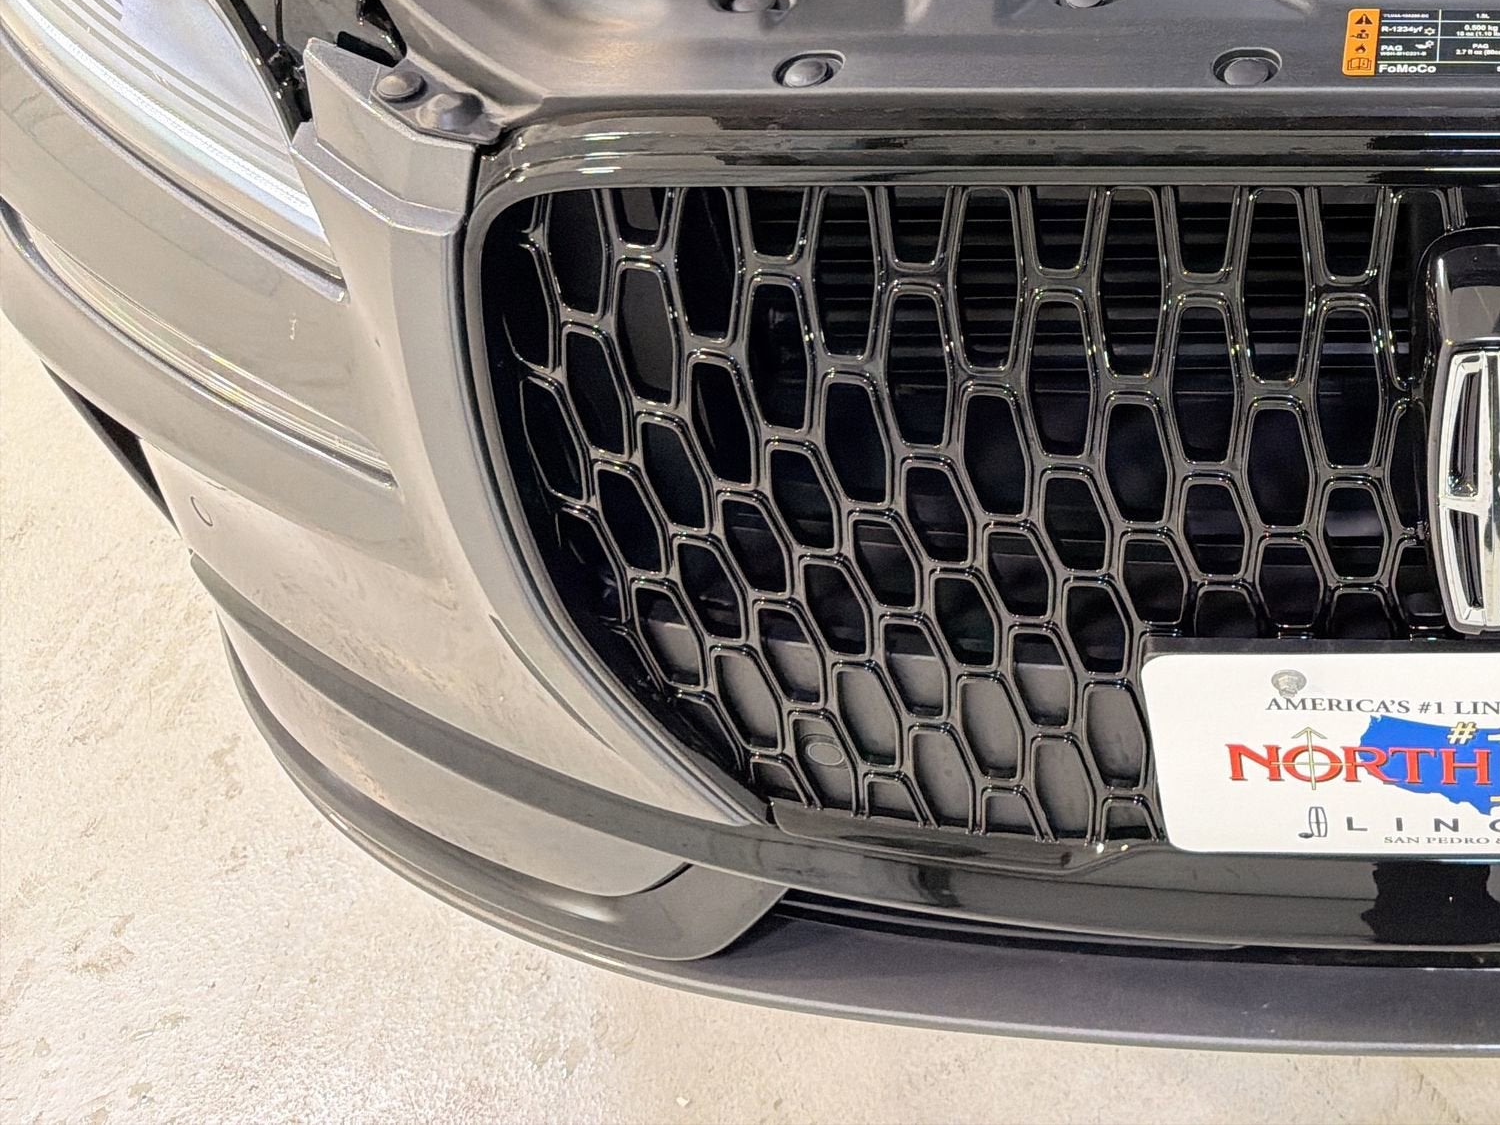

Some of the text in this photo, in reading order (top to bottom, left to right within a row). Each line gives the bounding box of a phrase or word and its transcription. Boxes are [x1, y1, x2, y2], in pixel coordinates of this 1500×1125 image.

[1381, 25, 1423, 34] R-1234yf
[1379, 64, 1437, 73] FoMoCo
[1265, 697, 1410, 714] AMERICA'S
[1418, 700, 1446, 714] #1
[1225, 743, 1493, 786] NORTH
[1384, 836, 1420, 844] SAN
[1425, 837, 1490, 845] PEDRO
